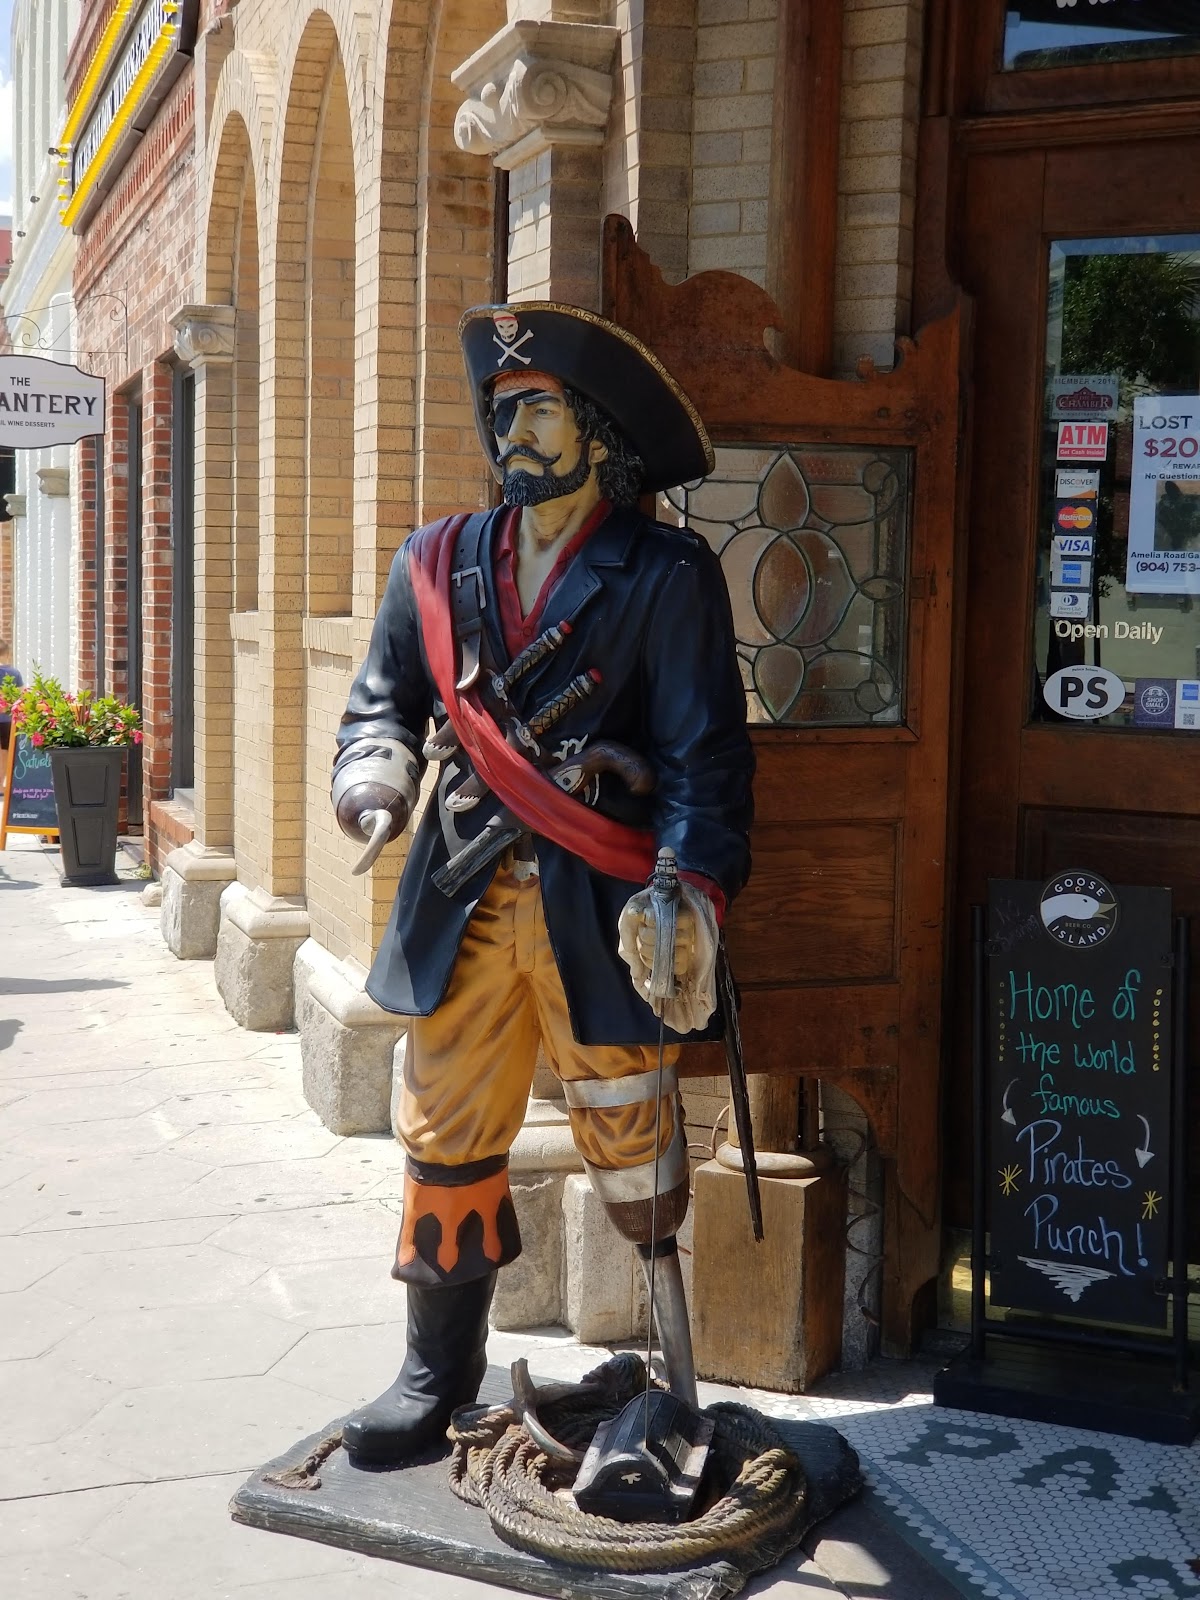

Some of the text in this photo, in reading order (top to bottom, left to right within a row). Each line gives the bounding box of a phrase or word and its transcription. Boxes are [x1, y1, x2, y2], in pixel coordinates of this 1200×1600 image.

[10, 376, 31, 387] THE
[1139, 415, 1193, 430] LOST
[1059, 425, 1107, 446] ATM
[1059, 539, 1090, 552] VISA
[1130, 551, 1161, 559] Amelia
[1135, 560, 1169, 574] (904)
[1054, 620, 1164, 645] Open Daily
[1059, 676, 1109, 709] PS
[1054, 877, 1106, 897] GOOSE
[1052, 925, 1107, 945] ISLAND
[1008, 968, 1141, 1029] Home of
[1015, 1031, 1061, 1071] the
[1031, 1073, 1120, 1119] famous
[1015, 1118, 1132, 1189] Pirates
